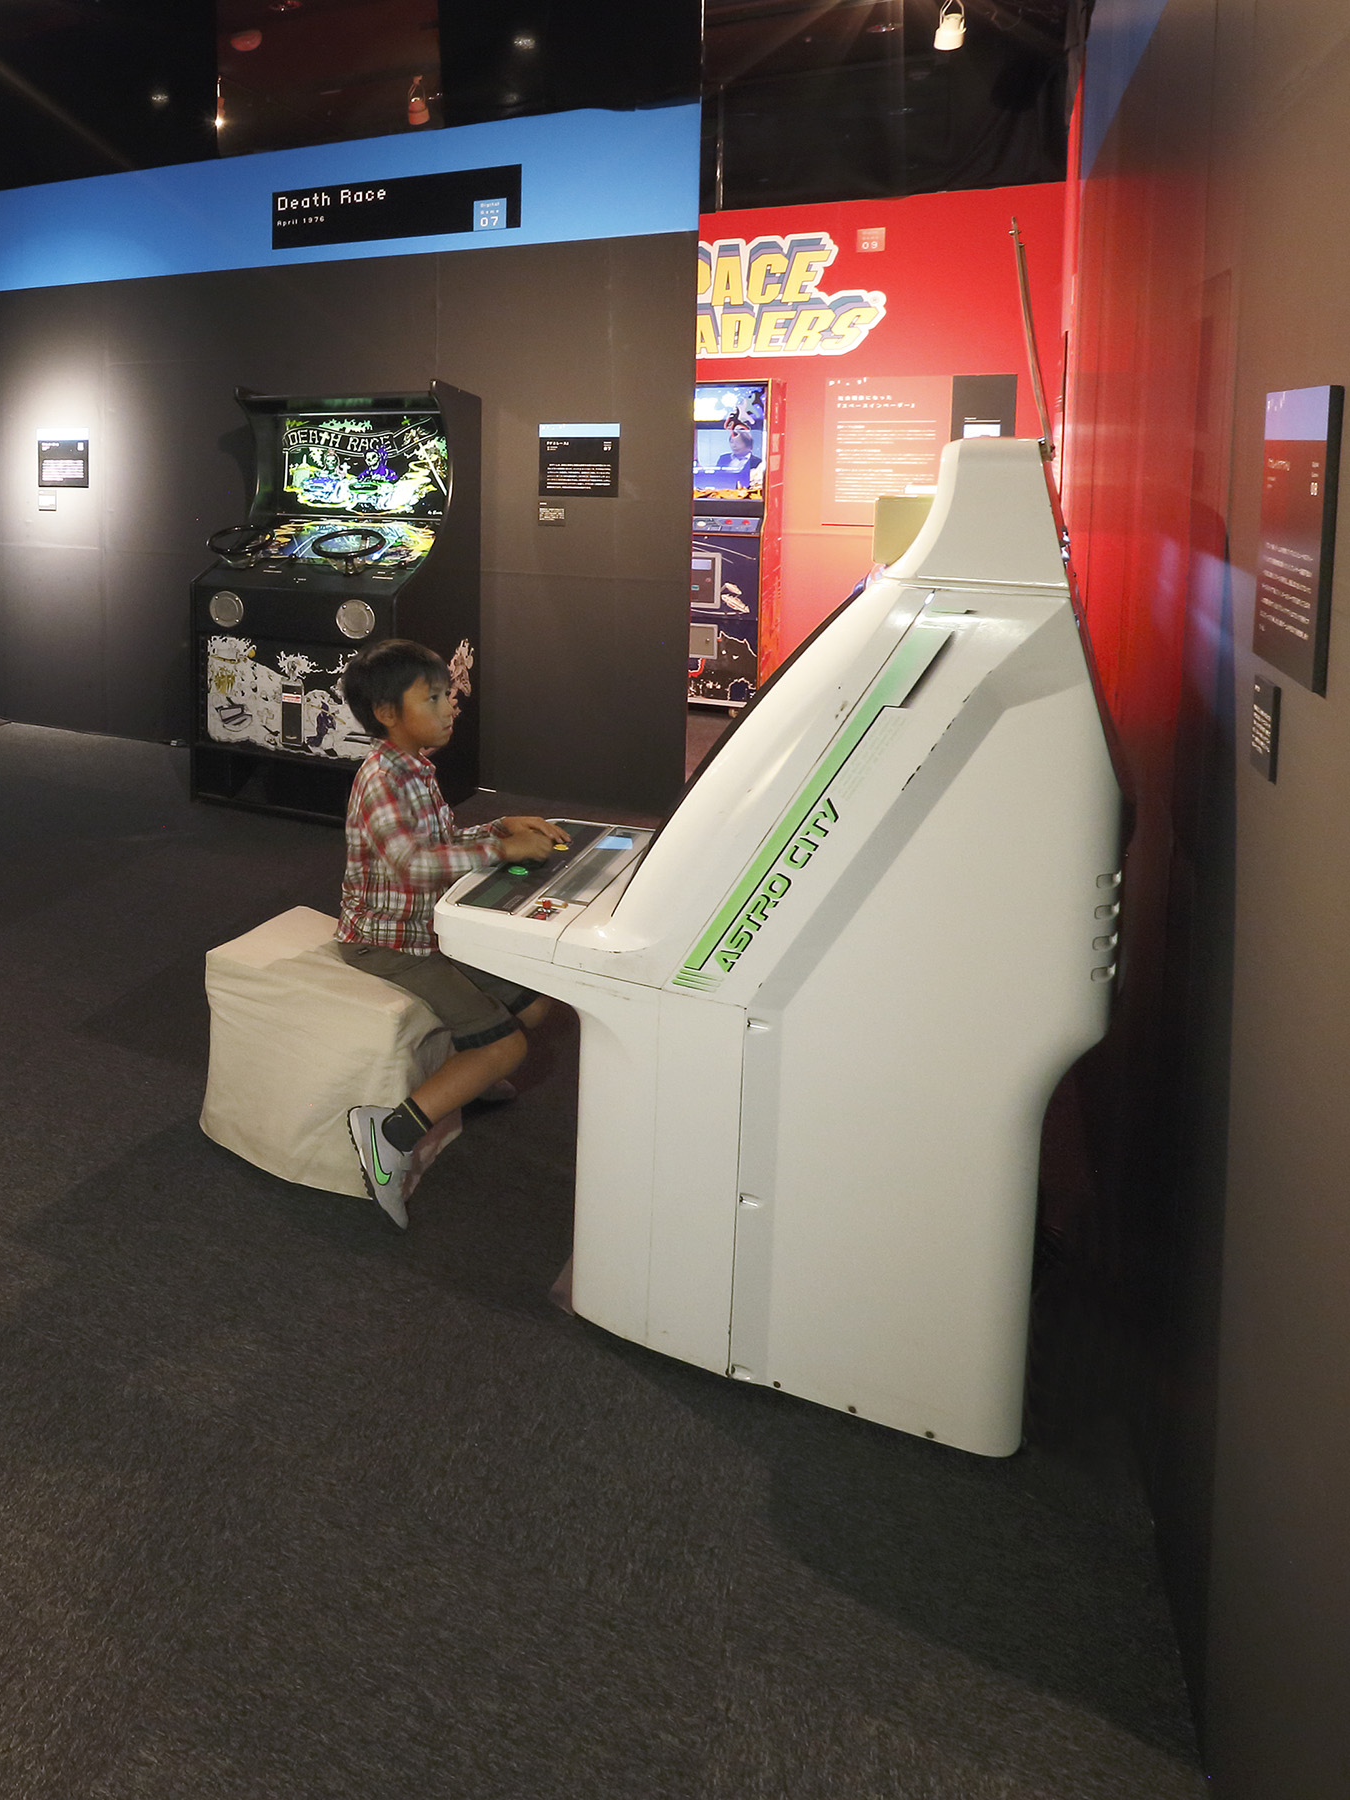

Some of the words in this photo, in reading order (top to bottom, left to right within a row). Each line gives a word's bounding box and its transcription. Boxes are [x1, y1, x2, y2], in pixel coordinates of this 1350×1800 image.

[277, 192, 331, 211] Death
[340, 189, 387, 205] Race
[277, 219, 298, 227] April
[480, 216, 499, 227] 07
[861, 241, 879, 250] 09
[287, 429, 342, 448] DEATH
[347, 435, 393, 451] RACE
[714, 872, 792, 973] ASTRO
[783, 797, 840, 870] CITY
